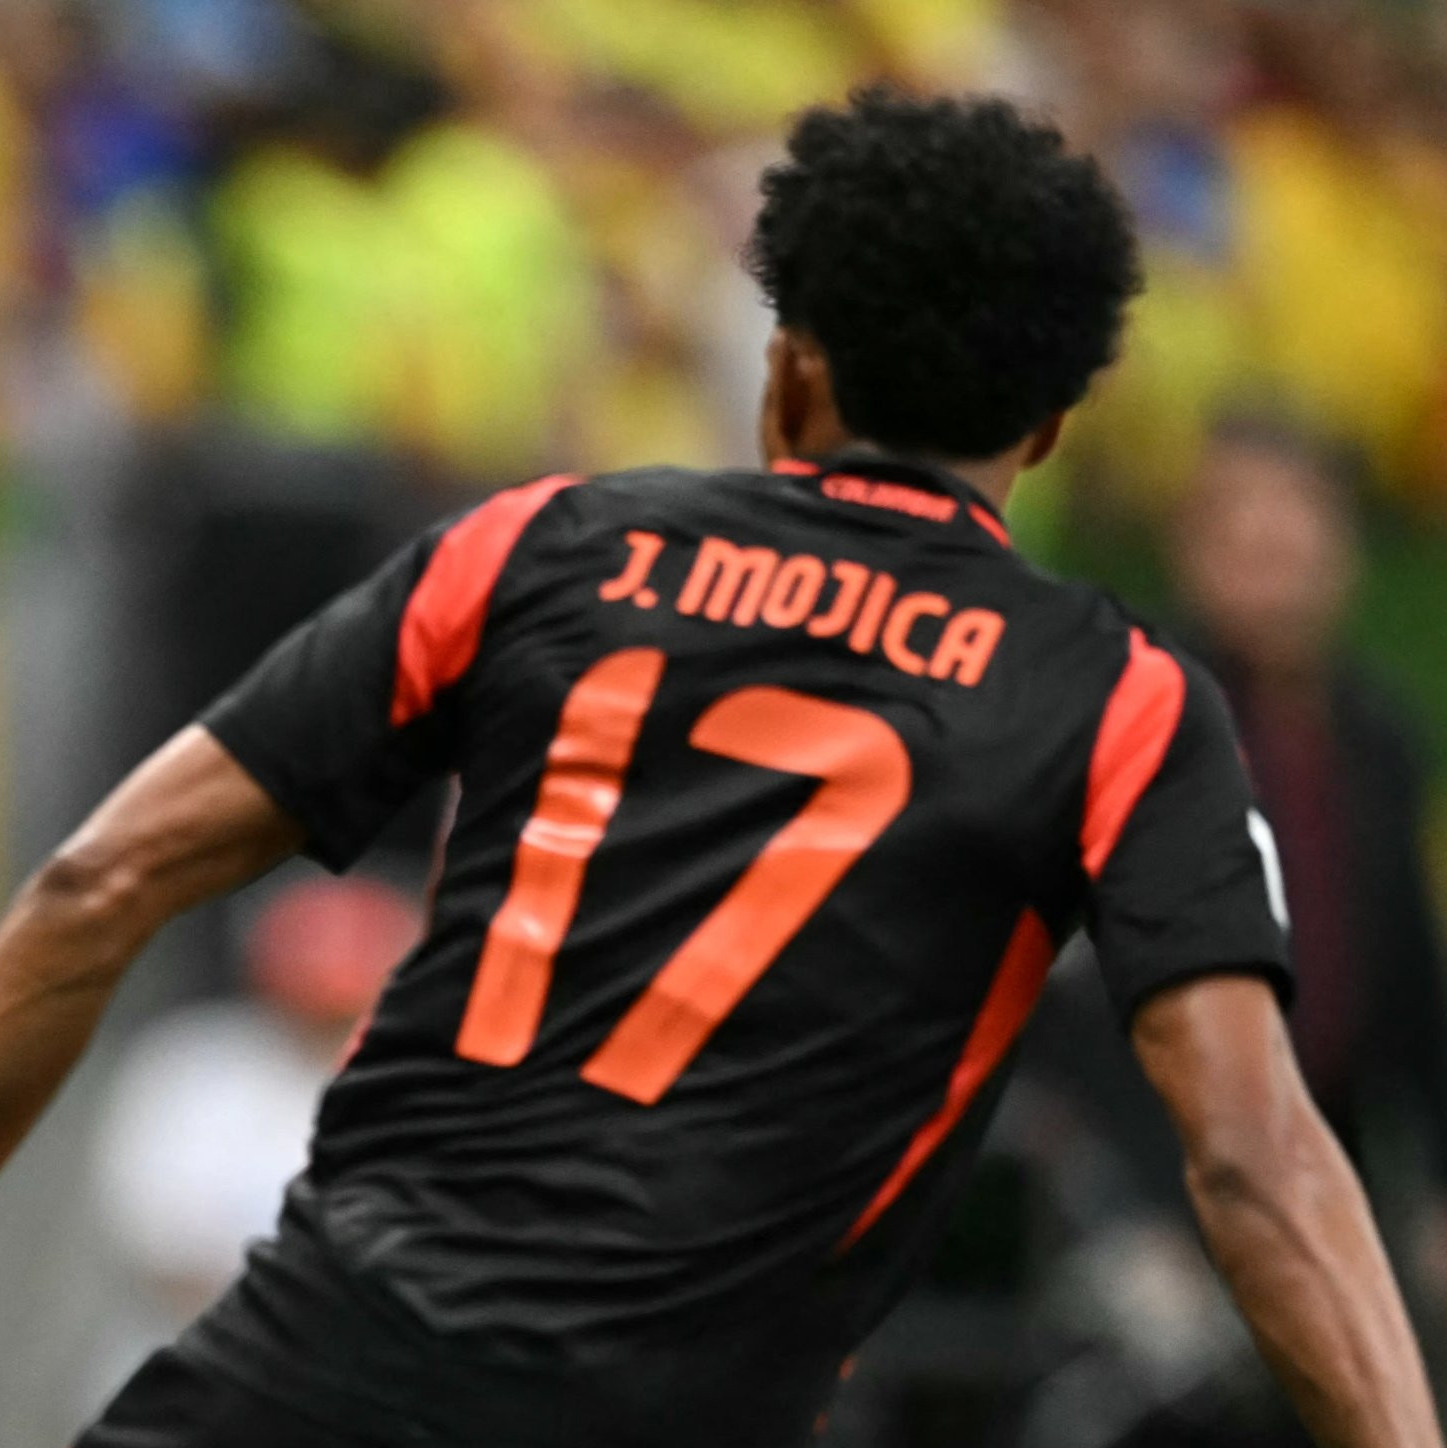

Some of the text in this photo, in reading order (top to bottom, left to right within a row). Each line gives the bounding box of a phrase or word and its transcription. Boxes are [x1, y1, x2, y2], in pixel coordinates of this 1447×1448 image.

[597, 529, 1007, 688] J. MOJICA
[454, 646, 912, 1106] 17
